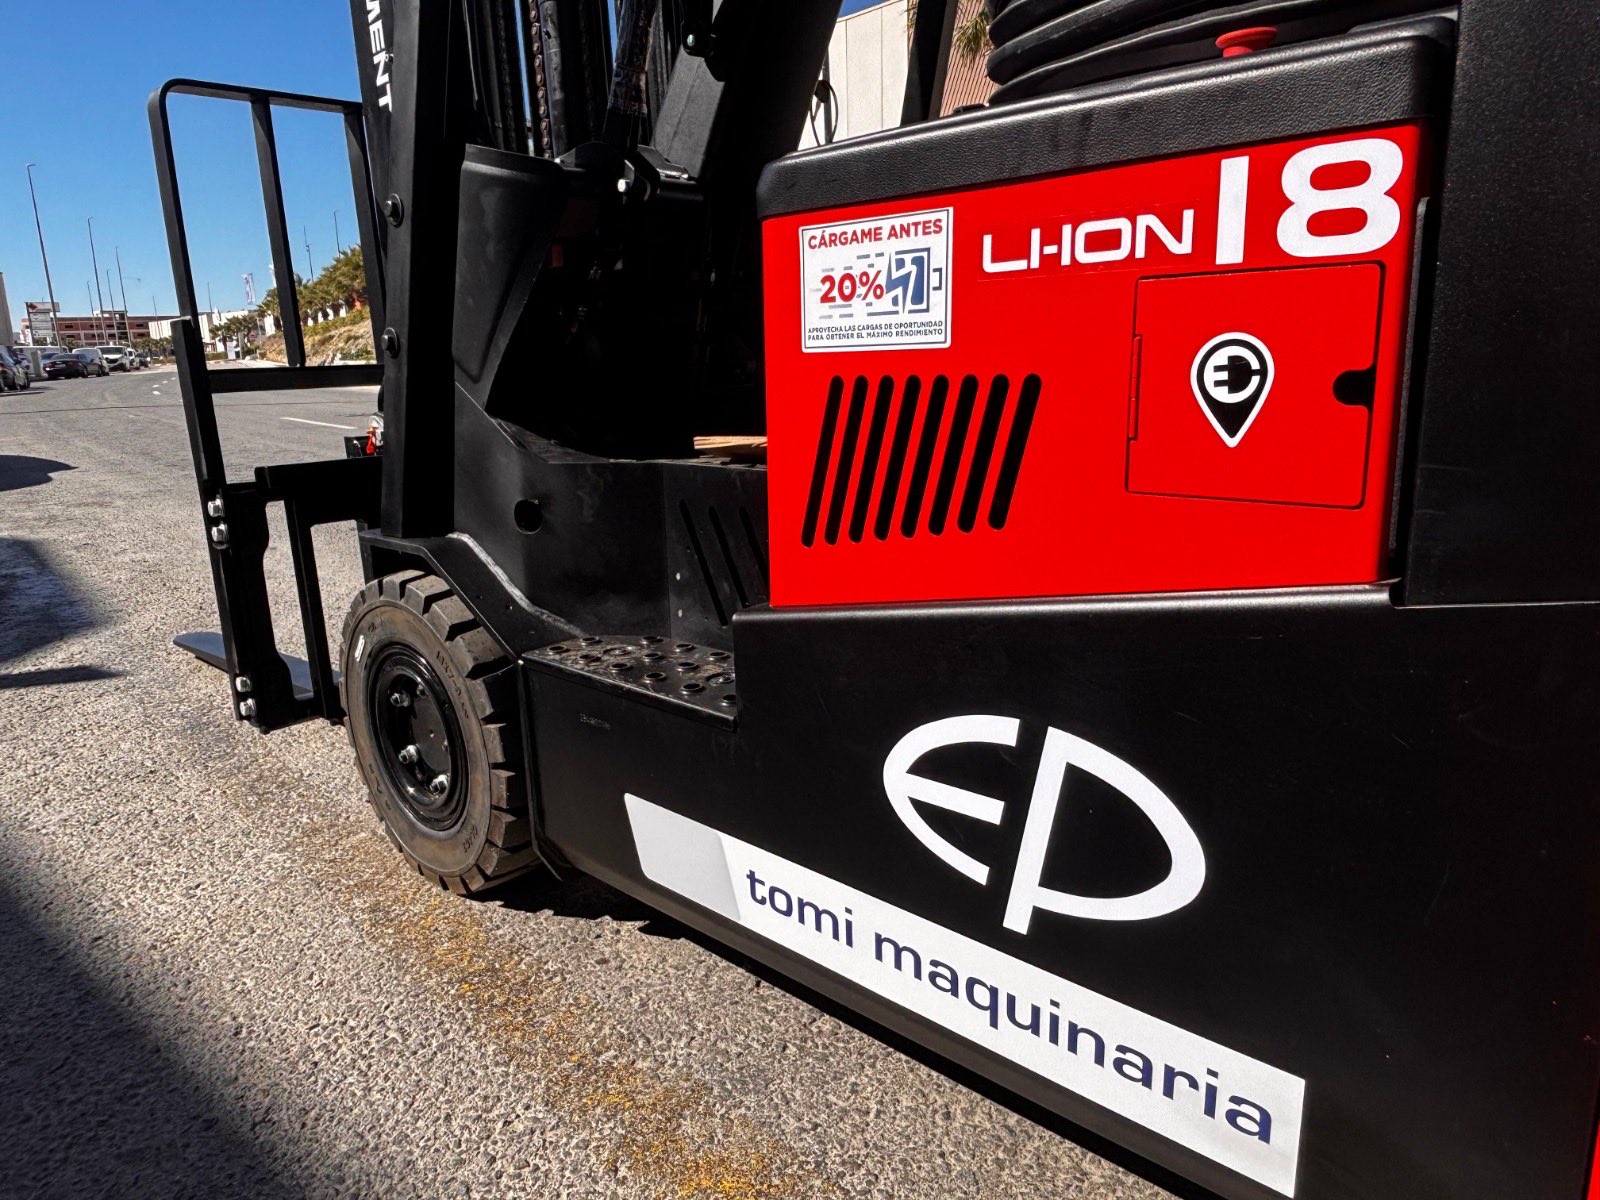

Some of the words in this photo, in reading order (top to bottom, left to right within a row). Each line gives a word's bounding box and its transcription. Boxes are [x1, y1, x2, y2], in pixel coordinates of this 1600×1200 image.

[982, 208, 1195, 273] LI-ION
[1215, 138, 1404, 265] 18
[808, 226, 883, 250] CÁRGAME
[887, 218, 943, 240] ANTES
[819, 269, 885, 304] 20%
[808, 326, 844, 334] APROVECHA
[844, 324, 856, 332] LAS
[894, 320, 943, 329] OPORTUNIDAD
[825, 332, 855, 340] OBTENER
[866, 330, 893, 338] MÁXIMO
[895, 328, 943, 337] RENDIMIENTO
[883, 714, 1206, 935] EP
[746, 869, 854, 948] tomi
[874, 930, 1273, 1145] maquinaria
